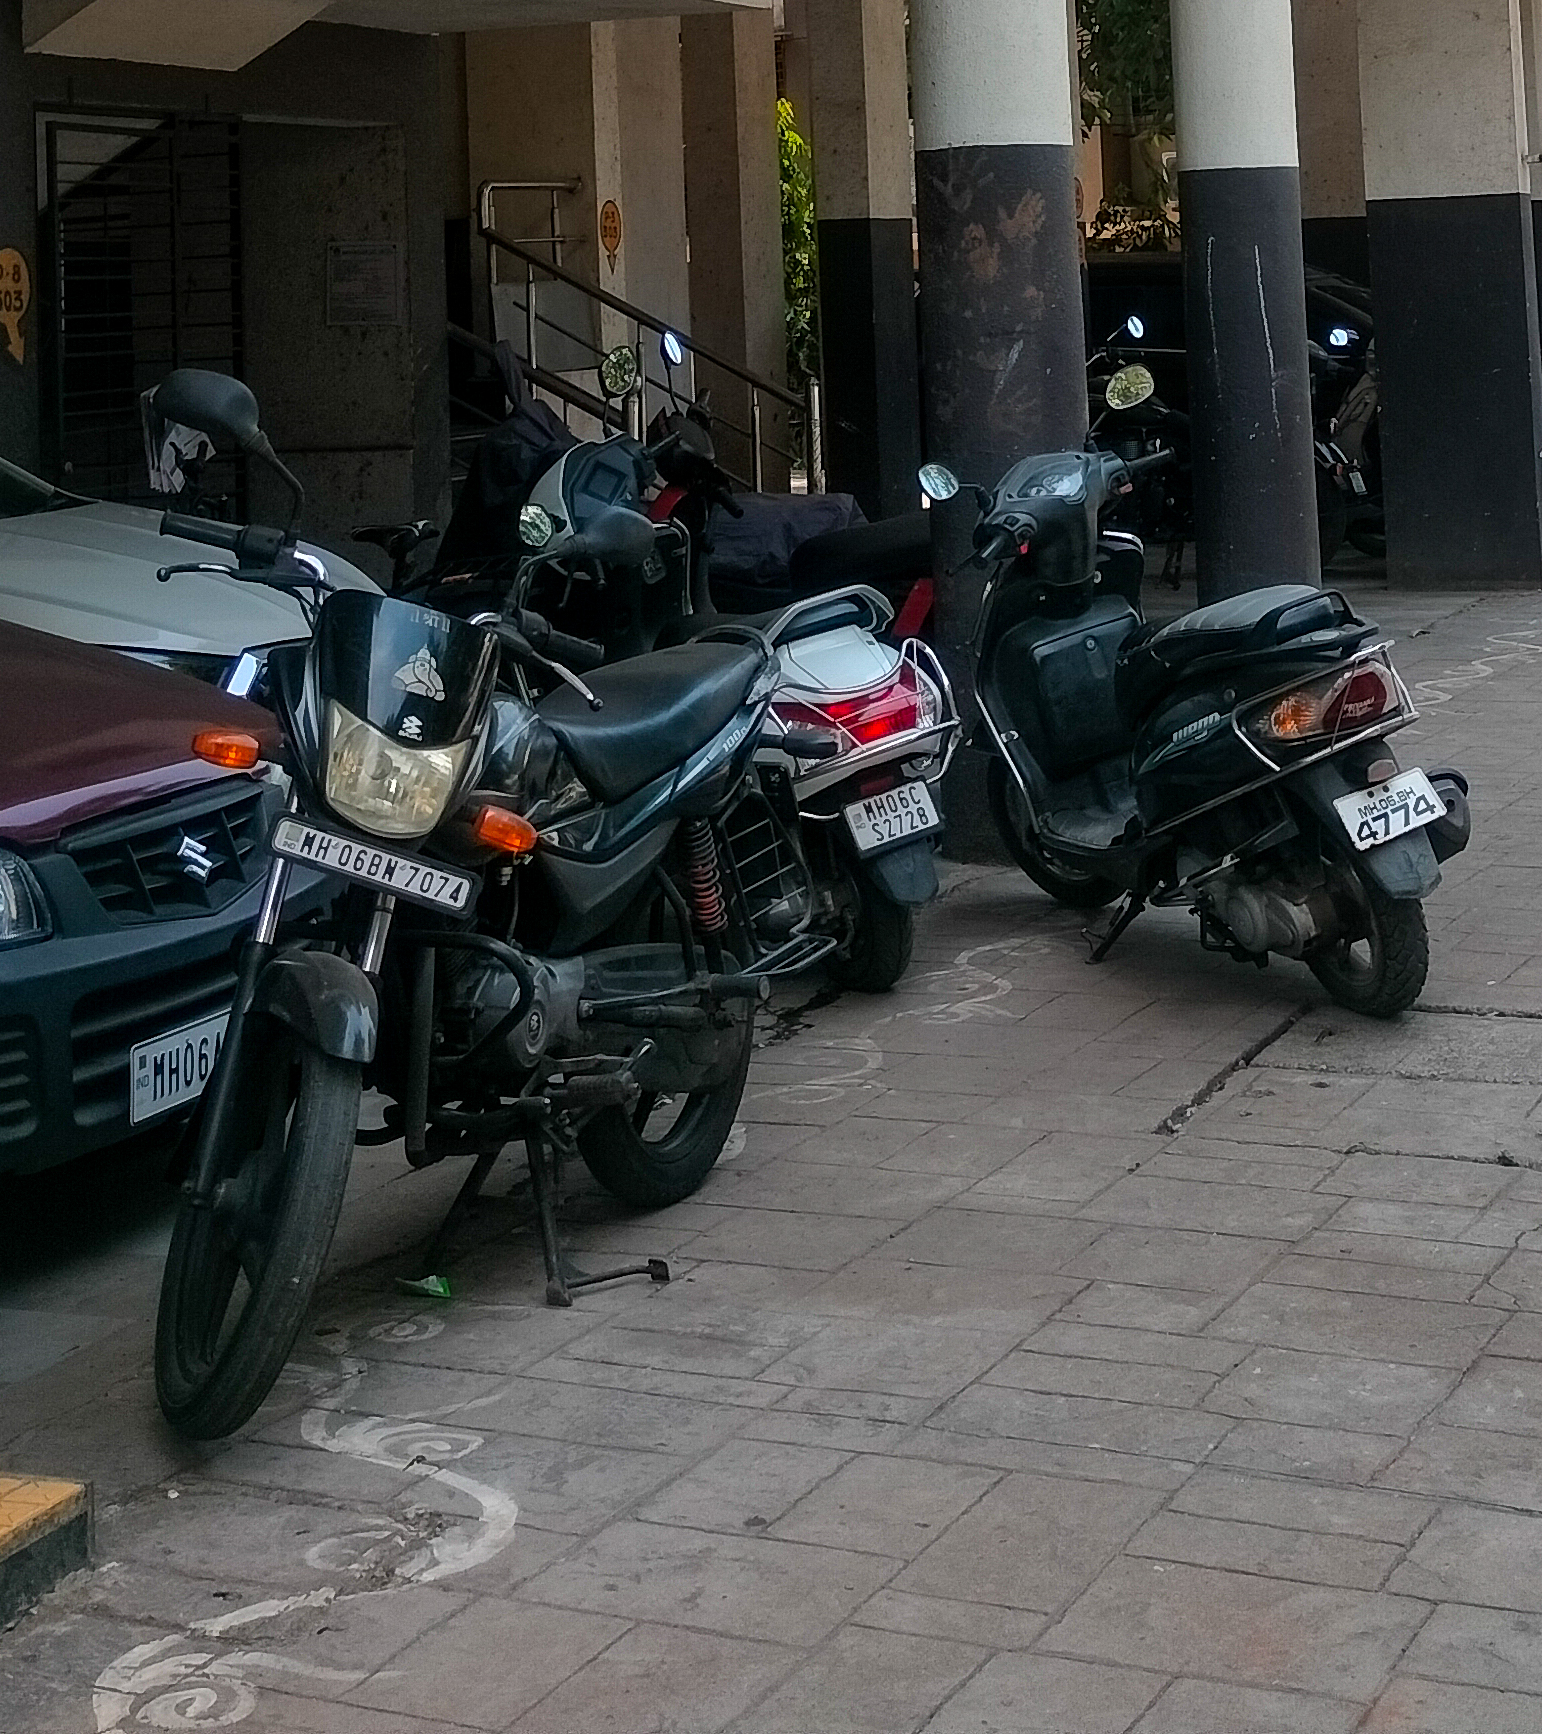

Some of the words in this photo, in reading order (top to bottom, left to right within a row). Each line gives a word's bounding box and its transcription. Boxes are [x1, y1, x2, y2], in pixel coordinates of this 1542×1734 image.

[862, 786, 921, 823] MH06C
[1356, 793, 1437, 843] 4774
[871, 806, 929, 842] S2728
